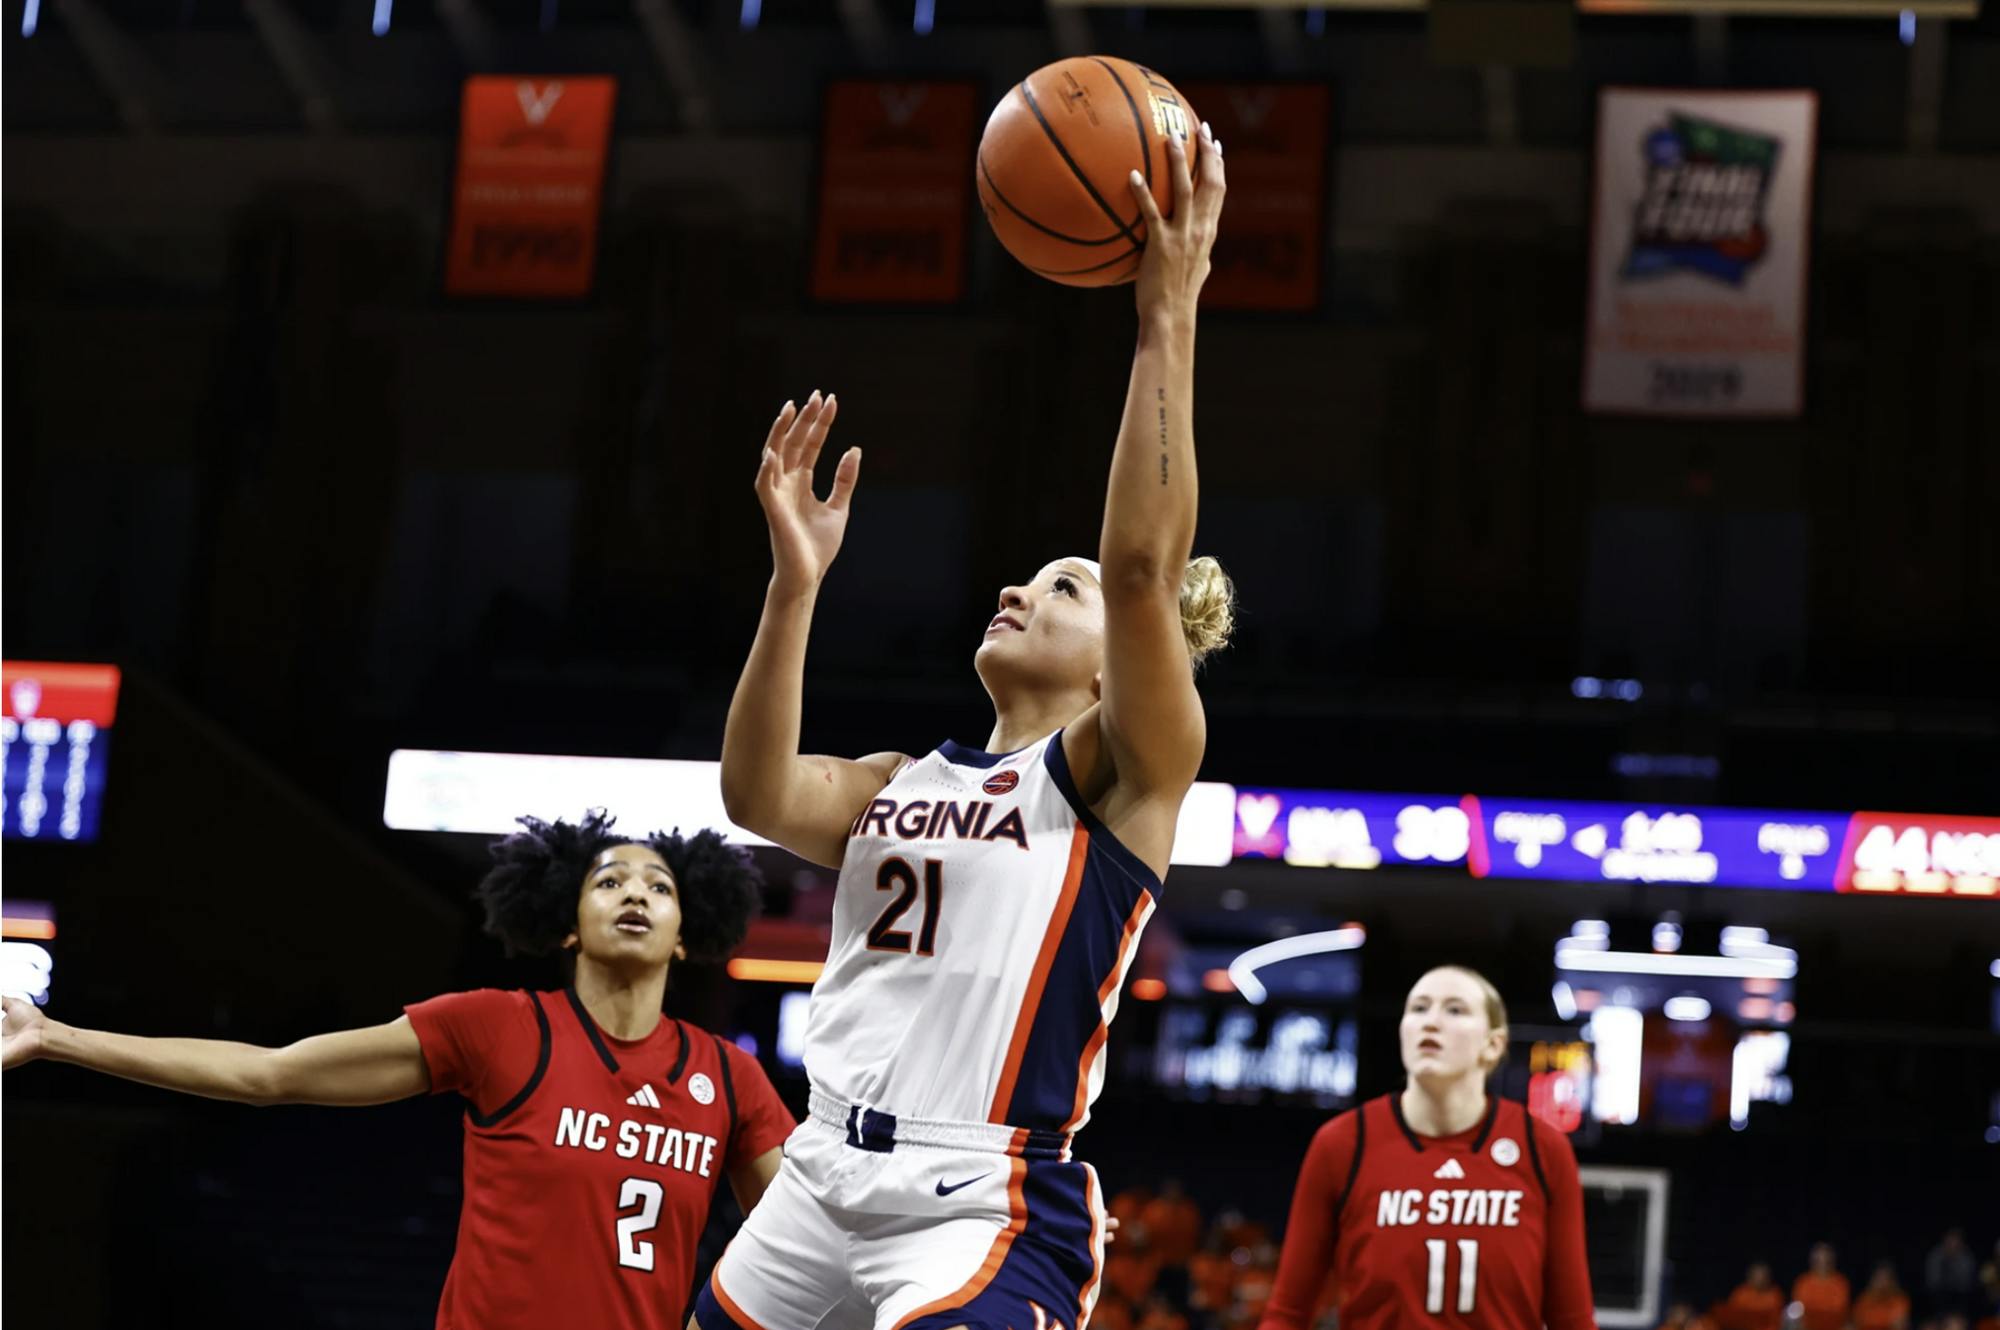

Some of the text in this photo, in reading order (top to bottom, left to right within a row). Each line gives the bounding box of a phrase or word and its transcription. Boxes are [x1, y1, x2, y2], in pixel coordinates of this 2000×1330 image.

[851, 798, 1029, 851] IRGINIA
[866, 856, 943, 956] 21
[555, 1107, 719, 1178] NC STATE
[616, 1177, 665, 1273] 2
[1376, 1189, 1524, 1228] NC STATE
[1425, 1238, 1479, 1315] 11
